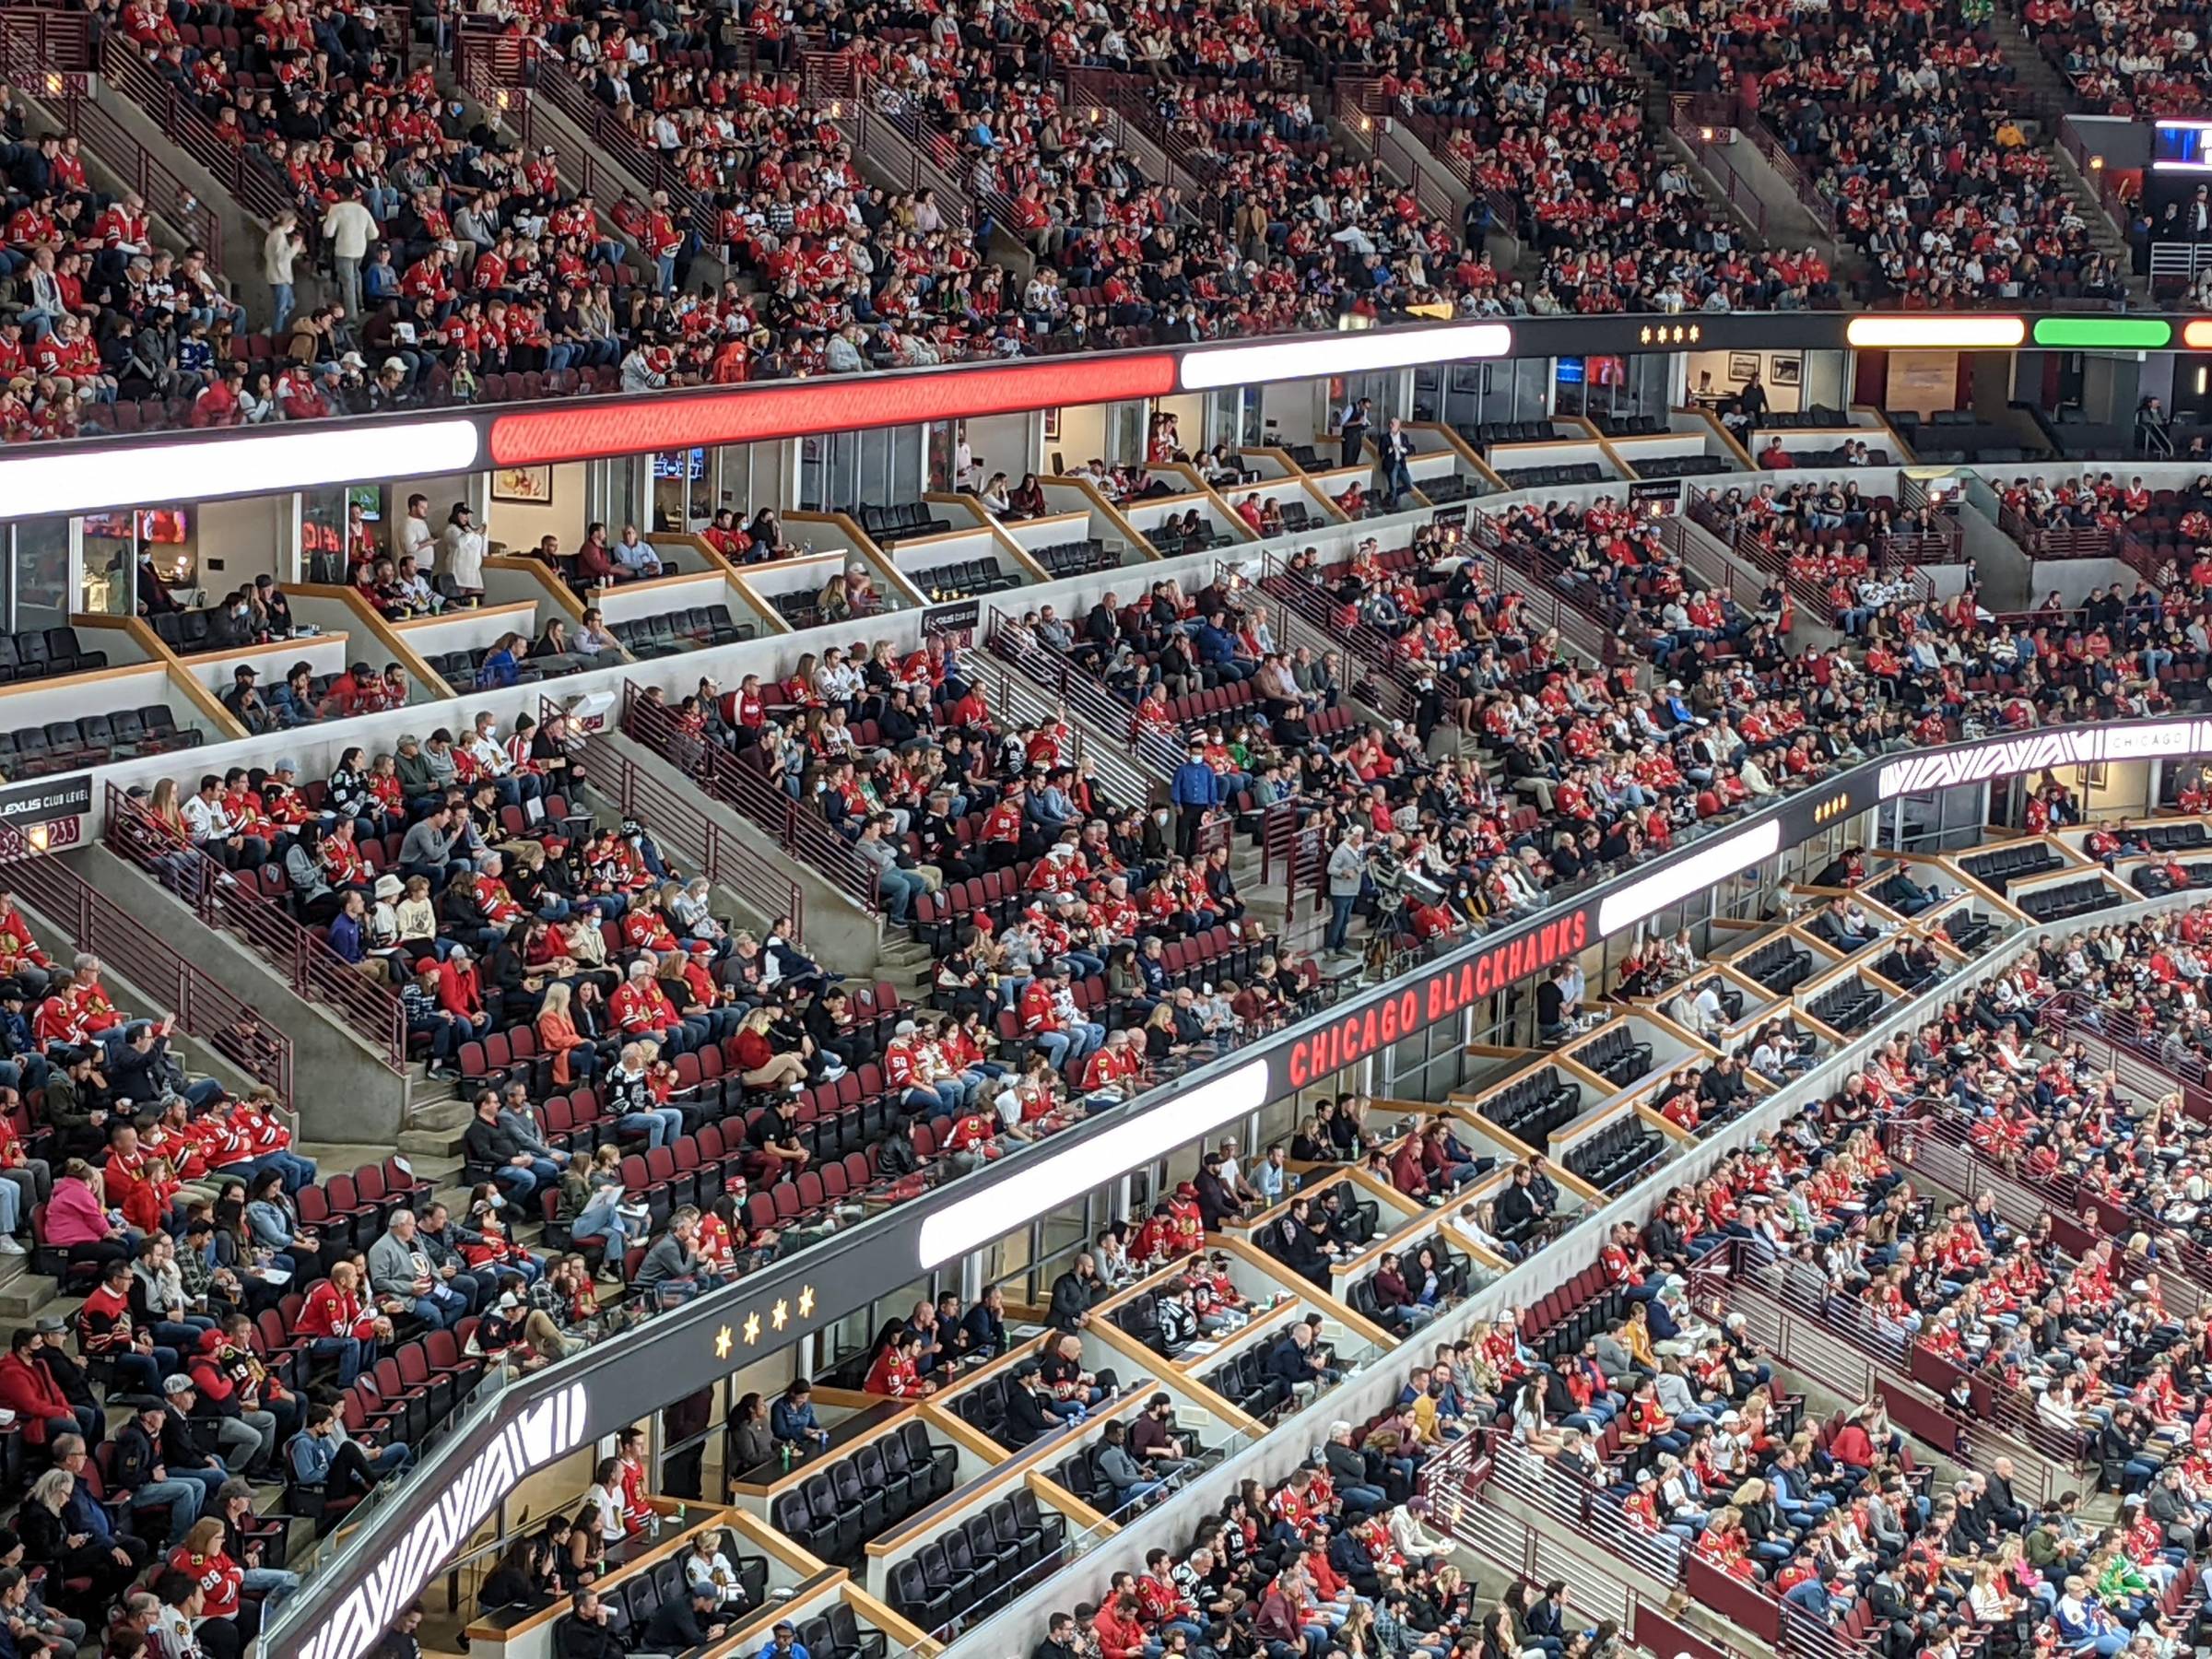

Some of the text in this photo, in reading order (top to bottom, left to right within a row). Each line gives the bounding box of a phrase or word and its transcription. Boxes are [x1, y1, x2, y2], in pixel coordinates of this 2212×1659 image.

[2112, 732, 2183, 749] CHICAGO
[42, 794, 65, 808] CLUB
[65, 789, 89, 804] LEVEL
[48, 818, 77, 846] 233
[1289, 910, 1587, 1087] CHICAGO BLACKHAWKS
[230, 1363, 249, 1382] 19
[888, 1374, 900, 1386] 19
[1231, 1533, 1244, 1547] 19
[200, 1569, 223, 1593] 88
